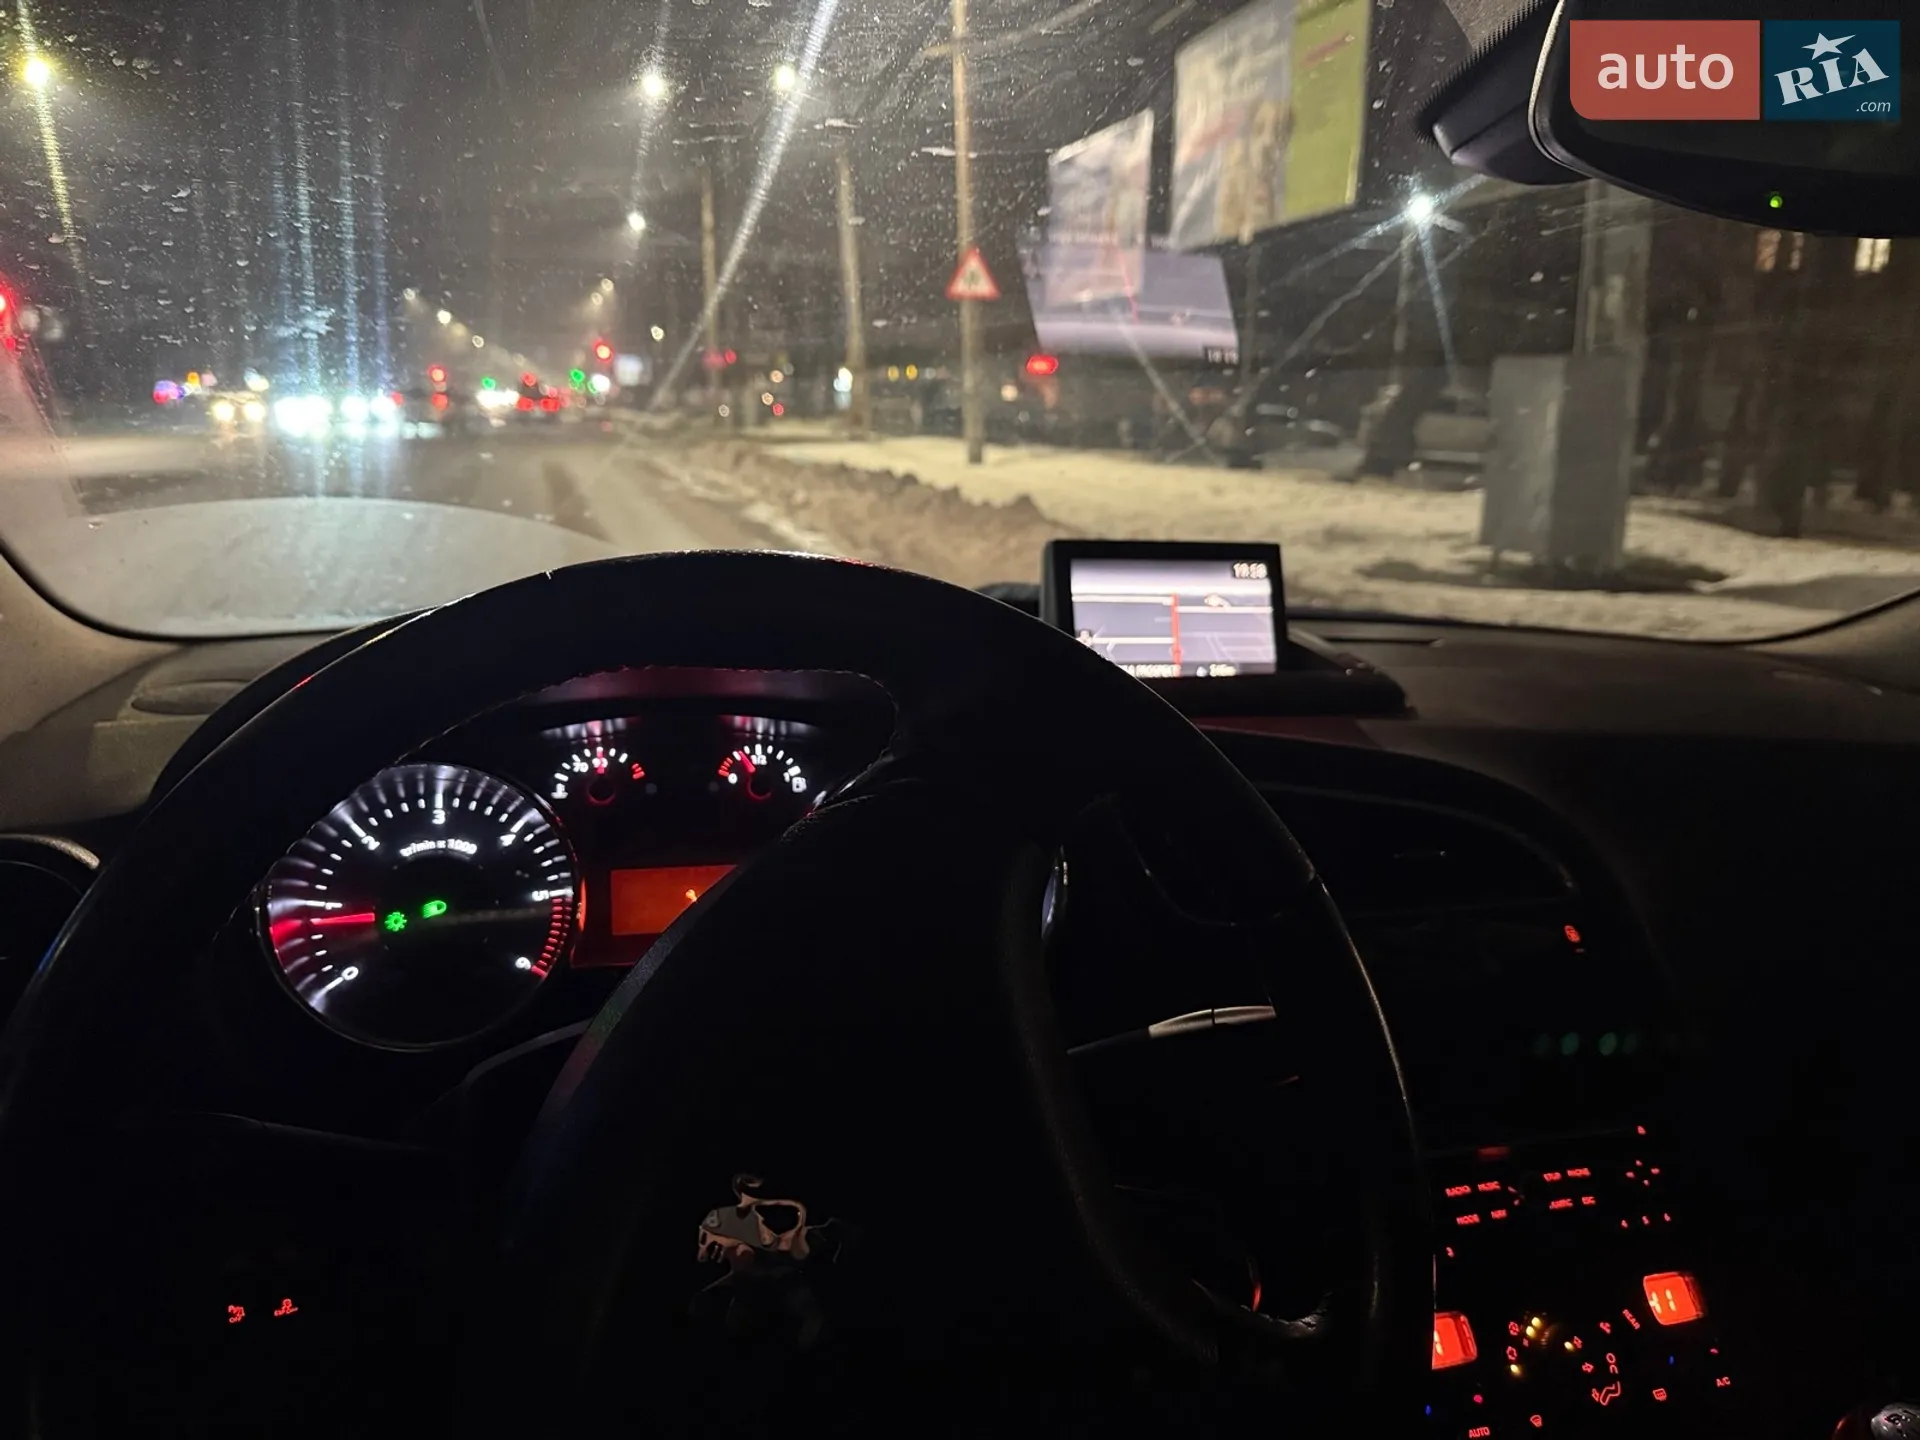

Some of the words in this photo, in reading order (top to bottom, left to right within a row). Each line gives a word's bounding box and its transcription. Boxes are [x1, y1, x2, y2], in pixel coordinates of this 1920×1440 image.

[432, 810, 446, 825] 3
[361, 835, 380, 850] 2
[501, 833, 516, 846] 4
[531, 890, 549, 900] 5
[514, 956, 531, 970] 6
[341, 966, 360, 981] 0
[1468, 1426, 1491, 1439] AUTO
